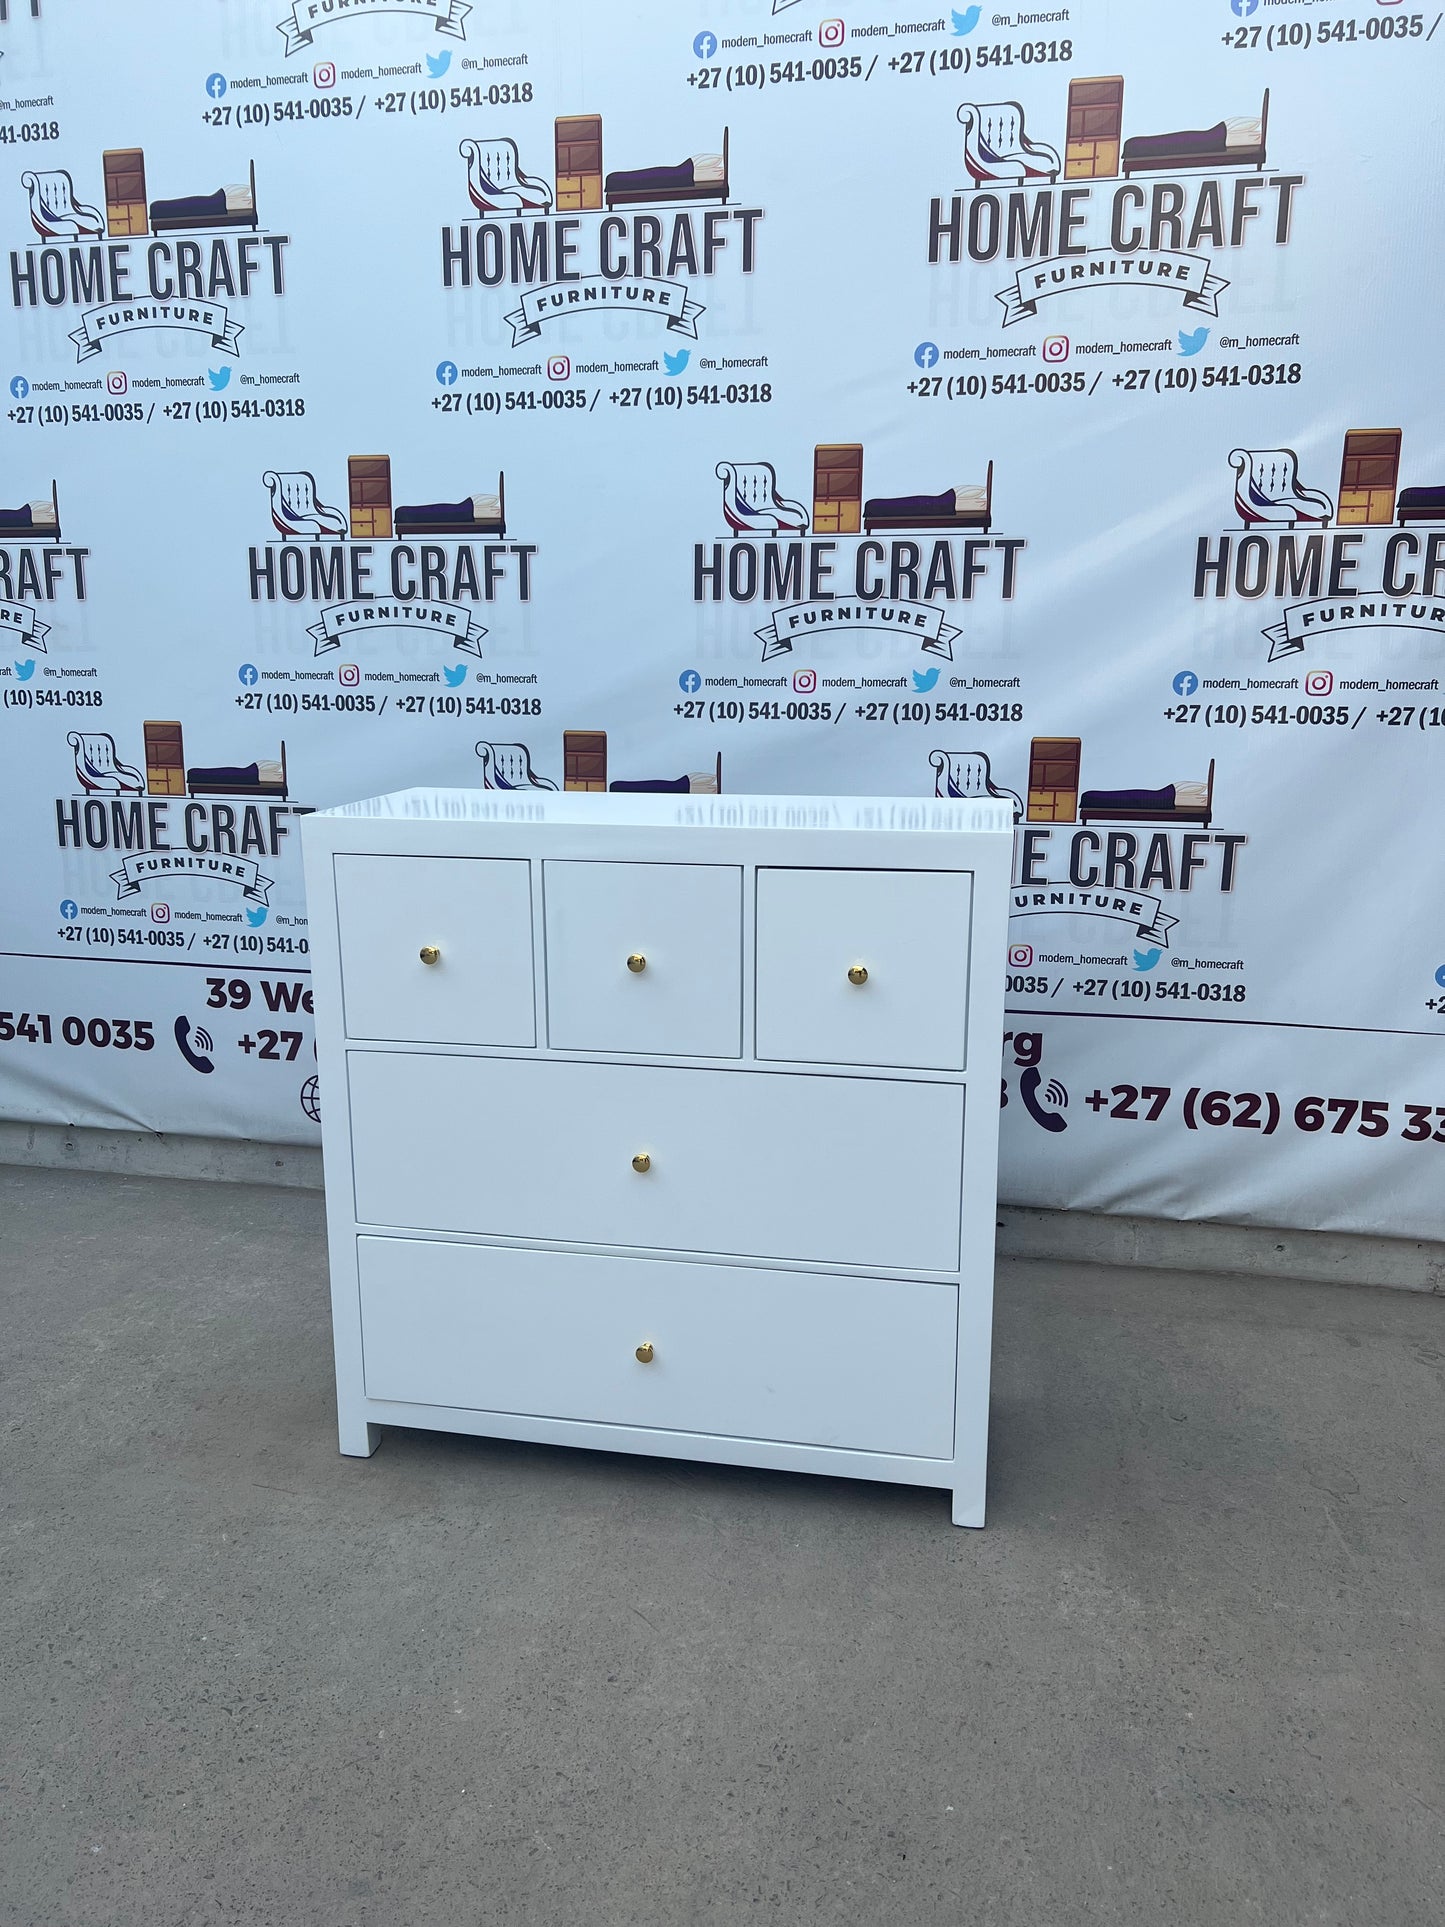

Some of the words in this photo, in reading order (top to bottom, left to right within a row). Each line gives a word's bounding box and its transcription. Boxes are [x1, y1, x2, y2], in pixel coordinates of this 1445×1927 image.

[992, 9, 1069, 27] @m_homecraft
[1221, 26, 1262, 49] +27
[1267, 23, 1311, 51] (10)
[1317, 14, 1423, 43] 541-0035
[461, 53, 528, 71] @m_homecraft
[687, 67, 721, 89] +27
[726, 64, 765, 92] (10)
[770, 56, 862, 83] 541-0035
[888, 51, 925, 73] +27
[930, 48, 971, 76] (10)
[976, 40, 1072, 68] 541-0318
[202, 106, 232, 126] +27
[236, 103, 269, 128] (10)
[274, 97, 352, 121] 541-0035
[374, 92, 406, 113] +27
[411, 89, 446, 115] (10)
[450, 82, 533, 108] 541-0318
[928, 188, 1090, 263] HOME
[1111, 175, 1303, 255] CRAFT
[442, 220, 580, 286] HOME
[600, 209, 762, 279] CRAFT
[10, 244, 133, 306] HOME
[148, 236, 288, 301] CRAFT
[1034, 260, 1190, 289] FURNITURE
[537, 286, 671, 312] FURNITURE
[96, 306, 213, 330] FURNITURE
[1219, 333, 1300, 350] @m_homecraft
[699, 356, 768, 370] @m_homecraft
[240, 373, 300, 386] @m_homecraft
[907, 377, 943, 397] +27
[947, 375, 987, 400] (10)
[991, 372, 1085, 394] 541-0035
[1112, 369, 1150, 390] +27
[1155, 368, 1197, 393] (10)
[1202, 363, 1301, 387] 541-0318
[7, 406, 34, 423] +27
[38, 405, 68, 427] (10)
[72, 403, 143, 422] 541-0035
[163, 402, 191, 419] +27
[196, 401, 227, 423] (10)
[231, 399, 305, 418] 541-0318
[431, 393, 462, 412] +27
[467, 392, 501, 415] (10)
[505, 390, 586, 410] 541-0035
[609, 388, 642, 407] +27
[646, 386, 682, 410] (10)
[687, 383, 772, 405] 541-0318
[249, 546, 374, 601] HOME
[391, 545, 536, 601] CRAFT
[694, 542, 836, 602] HOME
[856, 539, 1025, 602] CRAFT
[1194, 534, 1363, 598] HOME
[335, 606, 456, 627] FURNITURE
[789, 607, 927, 629] FURNITURE
[43, 667, 98, 678] @m_homecraft
[476, 673, 538, 685] @m_homecraft
[949, 677, 1020, 689] @m_homecraft
[4, 689, 32, 709] (10)
[36, 690, 102, 706] 541-0318
[235, 693, 263, 709] +27
[267, 693, 298, 714] (10)
[302, 694, 375, 712] 541-0035
[396, 696, 425, 713] +27
[429, 696, 462, 717] (10)
[466, 697, 541, 715] 541-0318
[673, 701, 705, 718] +27
[709, 701, 744, 723] (10)
[748, 702, 831, 720] 541-0035
[855, 703, 889, 720] +27
[893, 703, 930, 725] (10)
[935, 703, 1023, 721] 541-0318
[1164, 704, 1201, 723] +27
[1205, 705, 1246, 728] (10)
[1251, 705, 1349, 725] 541-0035
[1376, 707, 1415, 726] +27
[56, 799, 170, 851] HOME
[136, 857, 245, 878] FURNITURE
[1069, 830, 1246, 892] CRAFT
[57, 926, 82, 941] +27
[86, 927, 114, 946] (10)
[118, 929, 185, 947] 541-0035
[203, 934, 230, 949] +27
[234, 935, 263, 955] (10)
[1171, 957, 1244, 970] @m_homecraft
[206, 978, 251, 1010] 39
[1073, 979, 1108, 996] +27
[1112, 980, 1151, 1002] (10)
[1155, 982, 1246, 1002] 541-0318
[62, 1016, 155, 1051] 0035
[238, 1029, 303, 1061] +27
[1085, 1084, 1171, 1121] +27
[1183, 1087, 1280, 1135] (62)
[1294, 1096, 1389, 1137] 675
